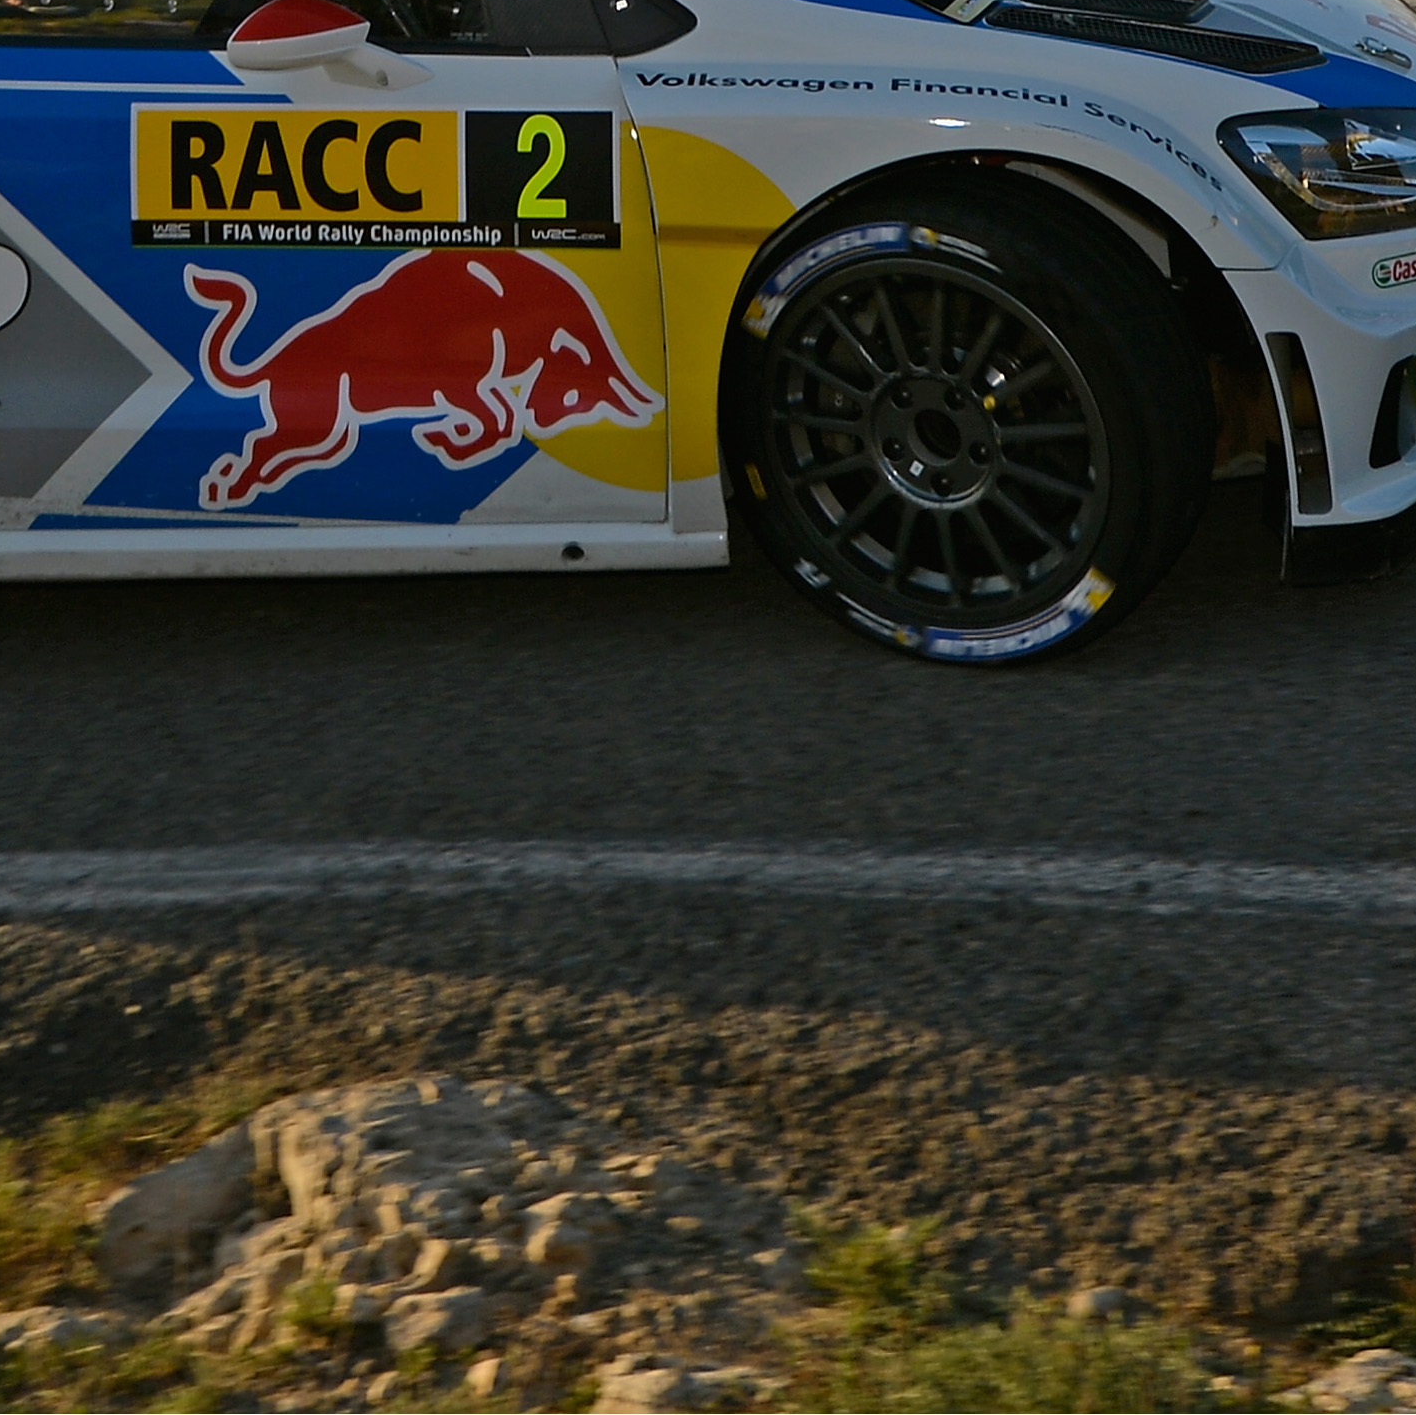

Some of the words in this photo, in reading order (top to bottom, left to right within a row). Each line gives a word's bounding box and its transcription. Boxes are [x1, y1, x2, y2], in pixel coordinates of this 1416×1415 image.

[170, 119, 423, 212] RACC
[516, 113, 567, 219] 2
[636, 71, 875, 93] Volkswagen
[890, 77, 1069, 108] Financial
[1083, 100, 1225, 193] Services
[222, 224, 253, 242] FIA
[257, 224, 312, 242] World
[318, 224, 364, 245] Rally
[370, 224, 502, 246] Championship
